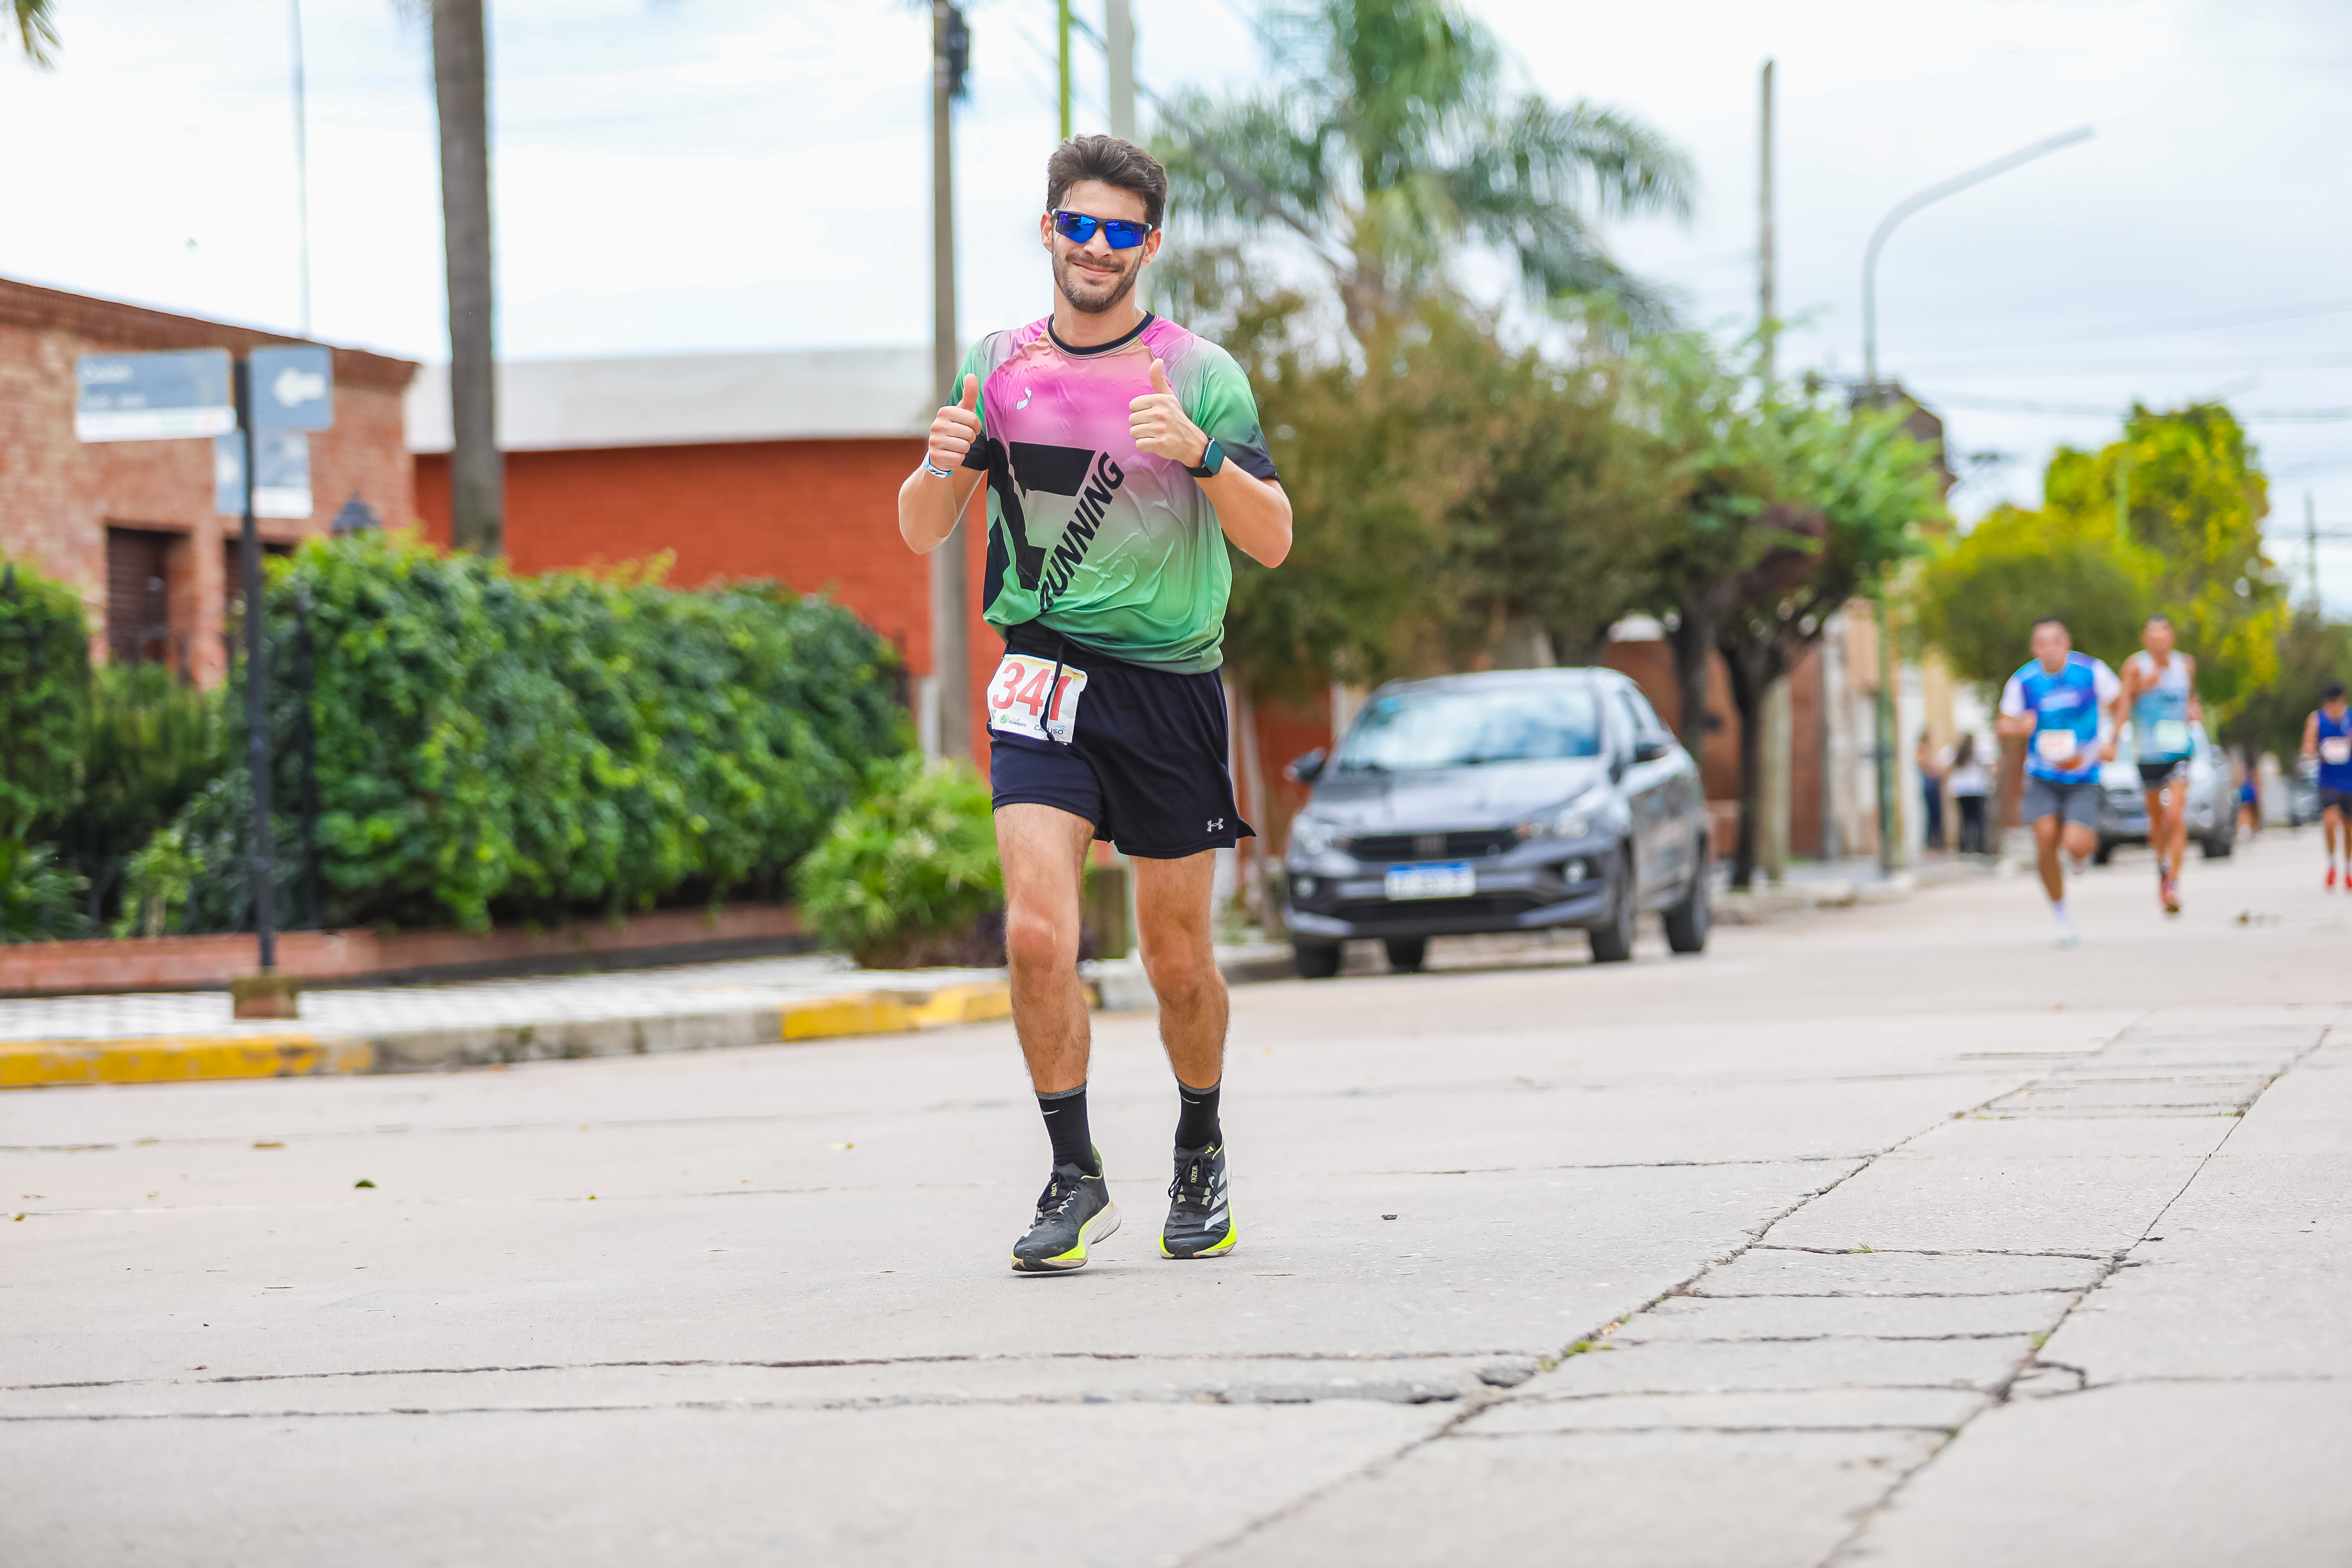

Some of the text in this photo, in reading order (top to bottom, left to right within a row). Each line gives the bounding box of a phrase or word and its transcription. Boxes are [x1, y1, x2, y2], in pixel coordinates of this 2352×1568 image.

[1040, 451, 1124, 614] RUNNING
[993, 662, 1072, 721] 341
[1034, 724, 1064, 735] CAUSO
